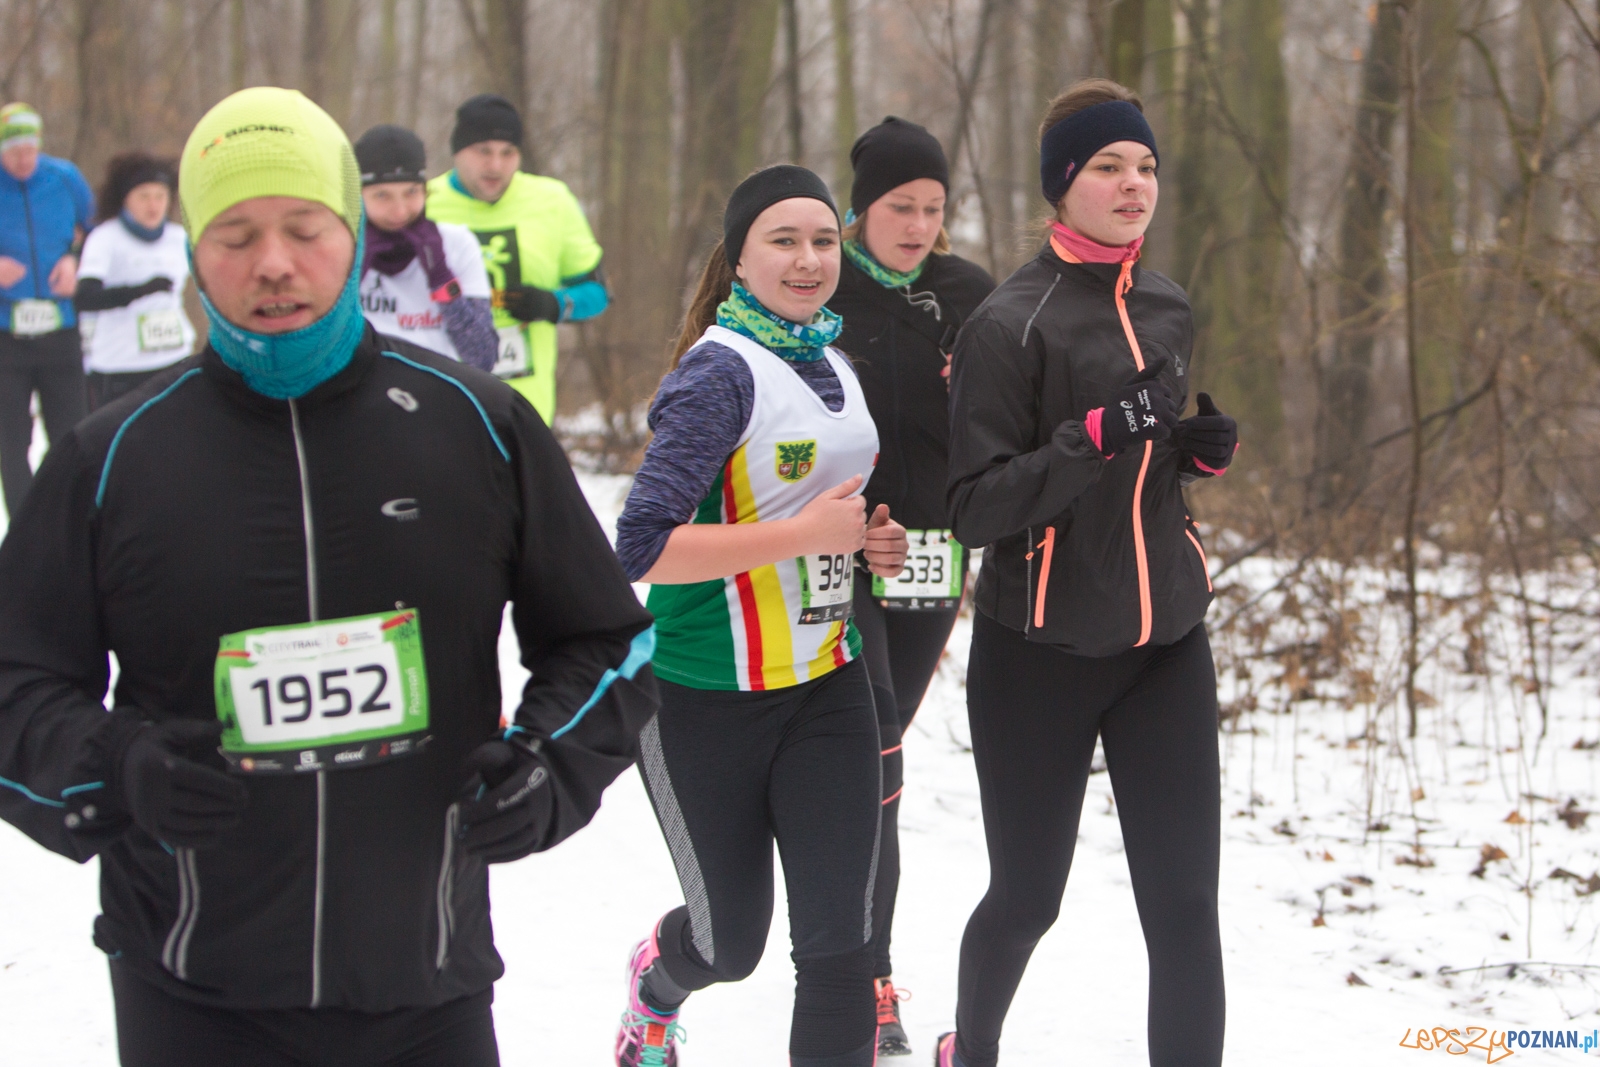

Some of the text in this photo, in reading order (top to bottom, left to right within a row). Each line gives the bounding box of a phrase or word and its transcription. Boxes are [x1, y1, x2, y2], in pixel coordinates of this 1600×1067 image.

[1125, 410, 1138, 433] asics
[818, 554, 852, 591] 394
[898, 555, 944, 583] 533
[251, 663, 392, 728] 1952
